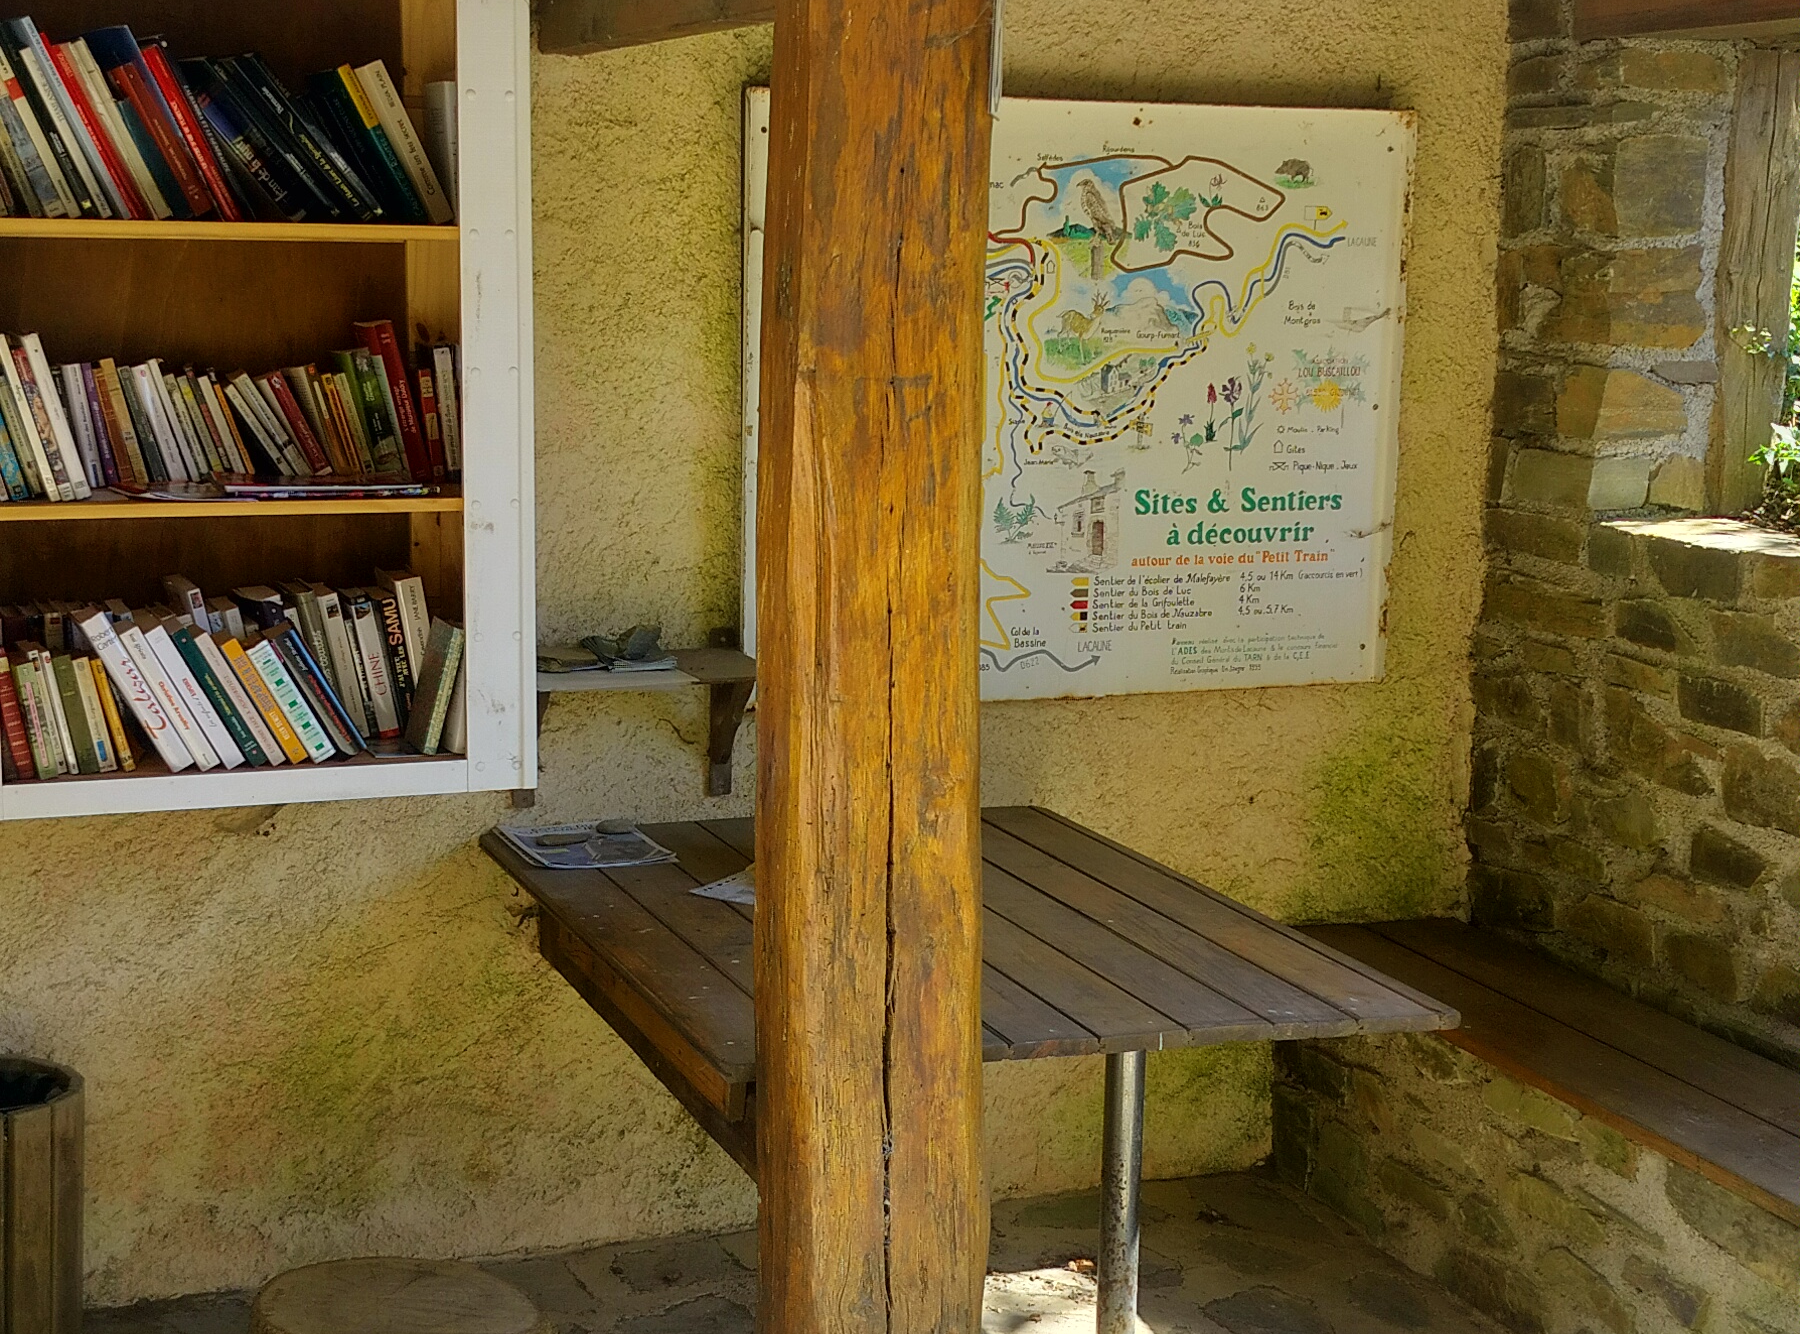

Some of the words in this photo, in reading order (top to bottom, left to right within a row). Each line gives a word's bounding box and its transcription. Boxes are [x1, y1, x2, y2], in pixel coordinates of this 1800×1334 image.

[1347, 237, 1378, 248] LACAUNE
[1134, 489, 1197, 515] Sites
[1207, 488, 1230, 513] &
[1240, 487, 1343, 513] Sentiers
[1166, 522, 1180, 546] à
[1187, 521, 1315, 546] découvrir
[1131, 556, 1172, 567] autour
[1175, 554, 1191, 566] de
[1194, 554, 1205, 565] la
[1208, 554, 1235, 565] voie
[1238, 552, 1255, 564] du
[1255, 550, 1290, 564] "Petit
[1294, 548, 1335, 563] Train"
[1093, 575, 1126, 586] Sentier
[1127, 575, 1136, 585] de
[1138, 574, 1170, 586] l'écolier
[1173, 573, 1184, 584] de
[1185, 572, 1231, 586] Malefayère
[1270, 571, 1279, 581] 14
[1279, 570, 1294, 580] Km
[1298, 569, 1334, 580] (raccourcis
[1093, 587, 1125, 598] Sentier
[1128, 587, 1139, 597] du
[1141, 586, 1160, 597] Bois
[1163, 586, 1174, 596] de
[1176, 586, 1192, 595] Luc
[1239, 583, 1246, 593] 6
[1247, 583, 1261, 593] Km
[1092, 599, 1125, 610] Sentier
[1128, 598, 1139, 608] de
[1141, 598, 1149, 608] la
[1152, 597, 1195, 609] Grifoulette
[1238, 594, 1245, 604] 4
[1246, 594, 1260, 604] Km
[1092, 610, 1125, 621] Sentier
[1128, 609, 1139, 620] du
[1140, 609, 1158, 619] Bois
[1160, 608, 1171, 619] de
[1280, 604, 1294, 613] Km
[378, 596, 405, 646] SAMU
[1092, 622, 1125, 633] Sentier
[1128, 621, 1138, 632] du
[1140, 620, 1162, 631] Petit
[1167, 619, 1187, 630] train
[1010, 627, 1021, 637] Col
[1021, 627, 1031, 636] de
[1032, 627, 1040, 636] la
[1014, 638, 1047, 648] Bassine
[1077, 640, 1112, 652] LACAUNE
[1244, 653, 1263, 662] TARN
[365, 651, 388, 696] CHINE
[155, 679, 178, 707] Christine
